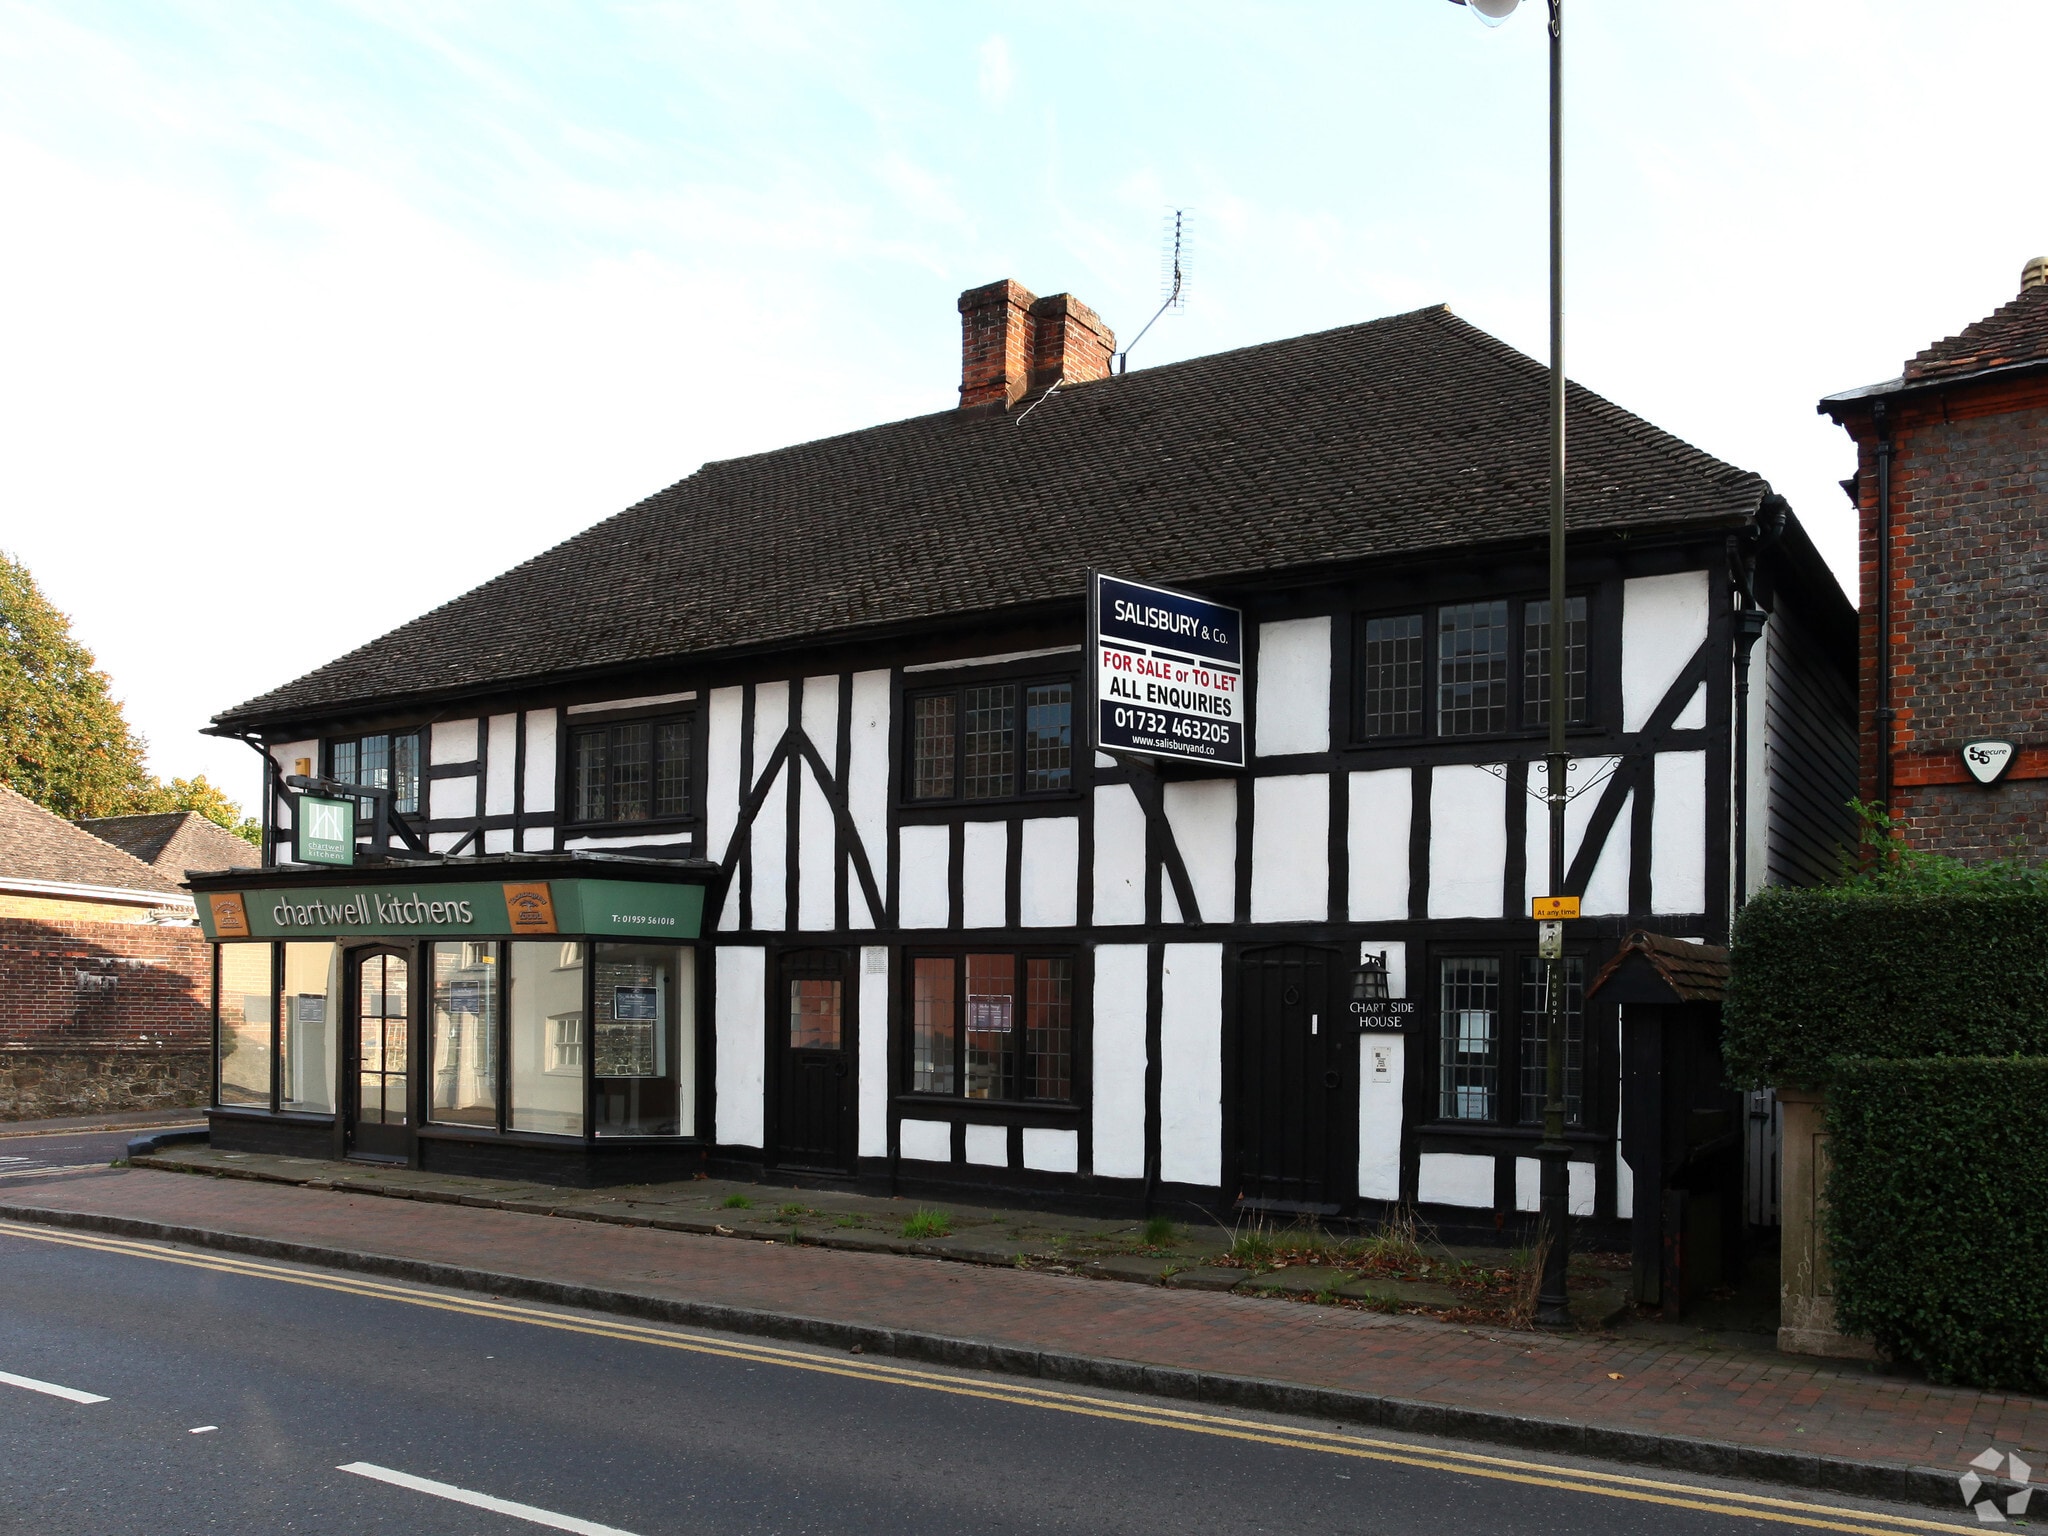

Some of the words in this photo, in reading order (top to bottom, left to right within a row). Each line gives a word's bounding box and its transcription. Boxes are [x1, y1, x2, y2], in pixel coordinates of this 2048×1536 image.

[1114, 599, 1200, 637] SALISBURY
[1201, 625, 1210, 640] &
[1212, 628, 1229, 645] Co.
[1103, 651, 1132, 672] FOR
[1136, 658, 1171, 680] SALE
[1175, 669, 1189, 683] or
[1192, 669, 1210, 688] TO
[1213, 673, 1237, 692] LET
[1109, 676, 1141, 700] ALL
[1147, 683, 1232, 717] ENQUIRIES
[1114, 707, 1166, 734] 01732
[1172, 717, 1230, 744] 463205
[1132, 734, 1215, 756] www.salisburyand.co
[308, 842, 345, 851] chartwell
[308, 849, 345, 860] kitchens
[273, 893, 372, 926] chartwell
[374, 891, 474, 924] kitchens
[1561, 908, 1577, 916] time
[611, 914, 621, 923] T:
[622, 915, 646, 924] 01959
[647, 916, 675, 926] 561018
[1349, 1001, 1386, 1013] CHART
[1390, 1001, 1415, 1013] SIDE
[1359, 1016, 1403, 1028] HOUSE
